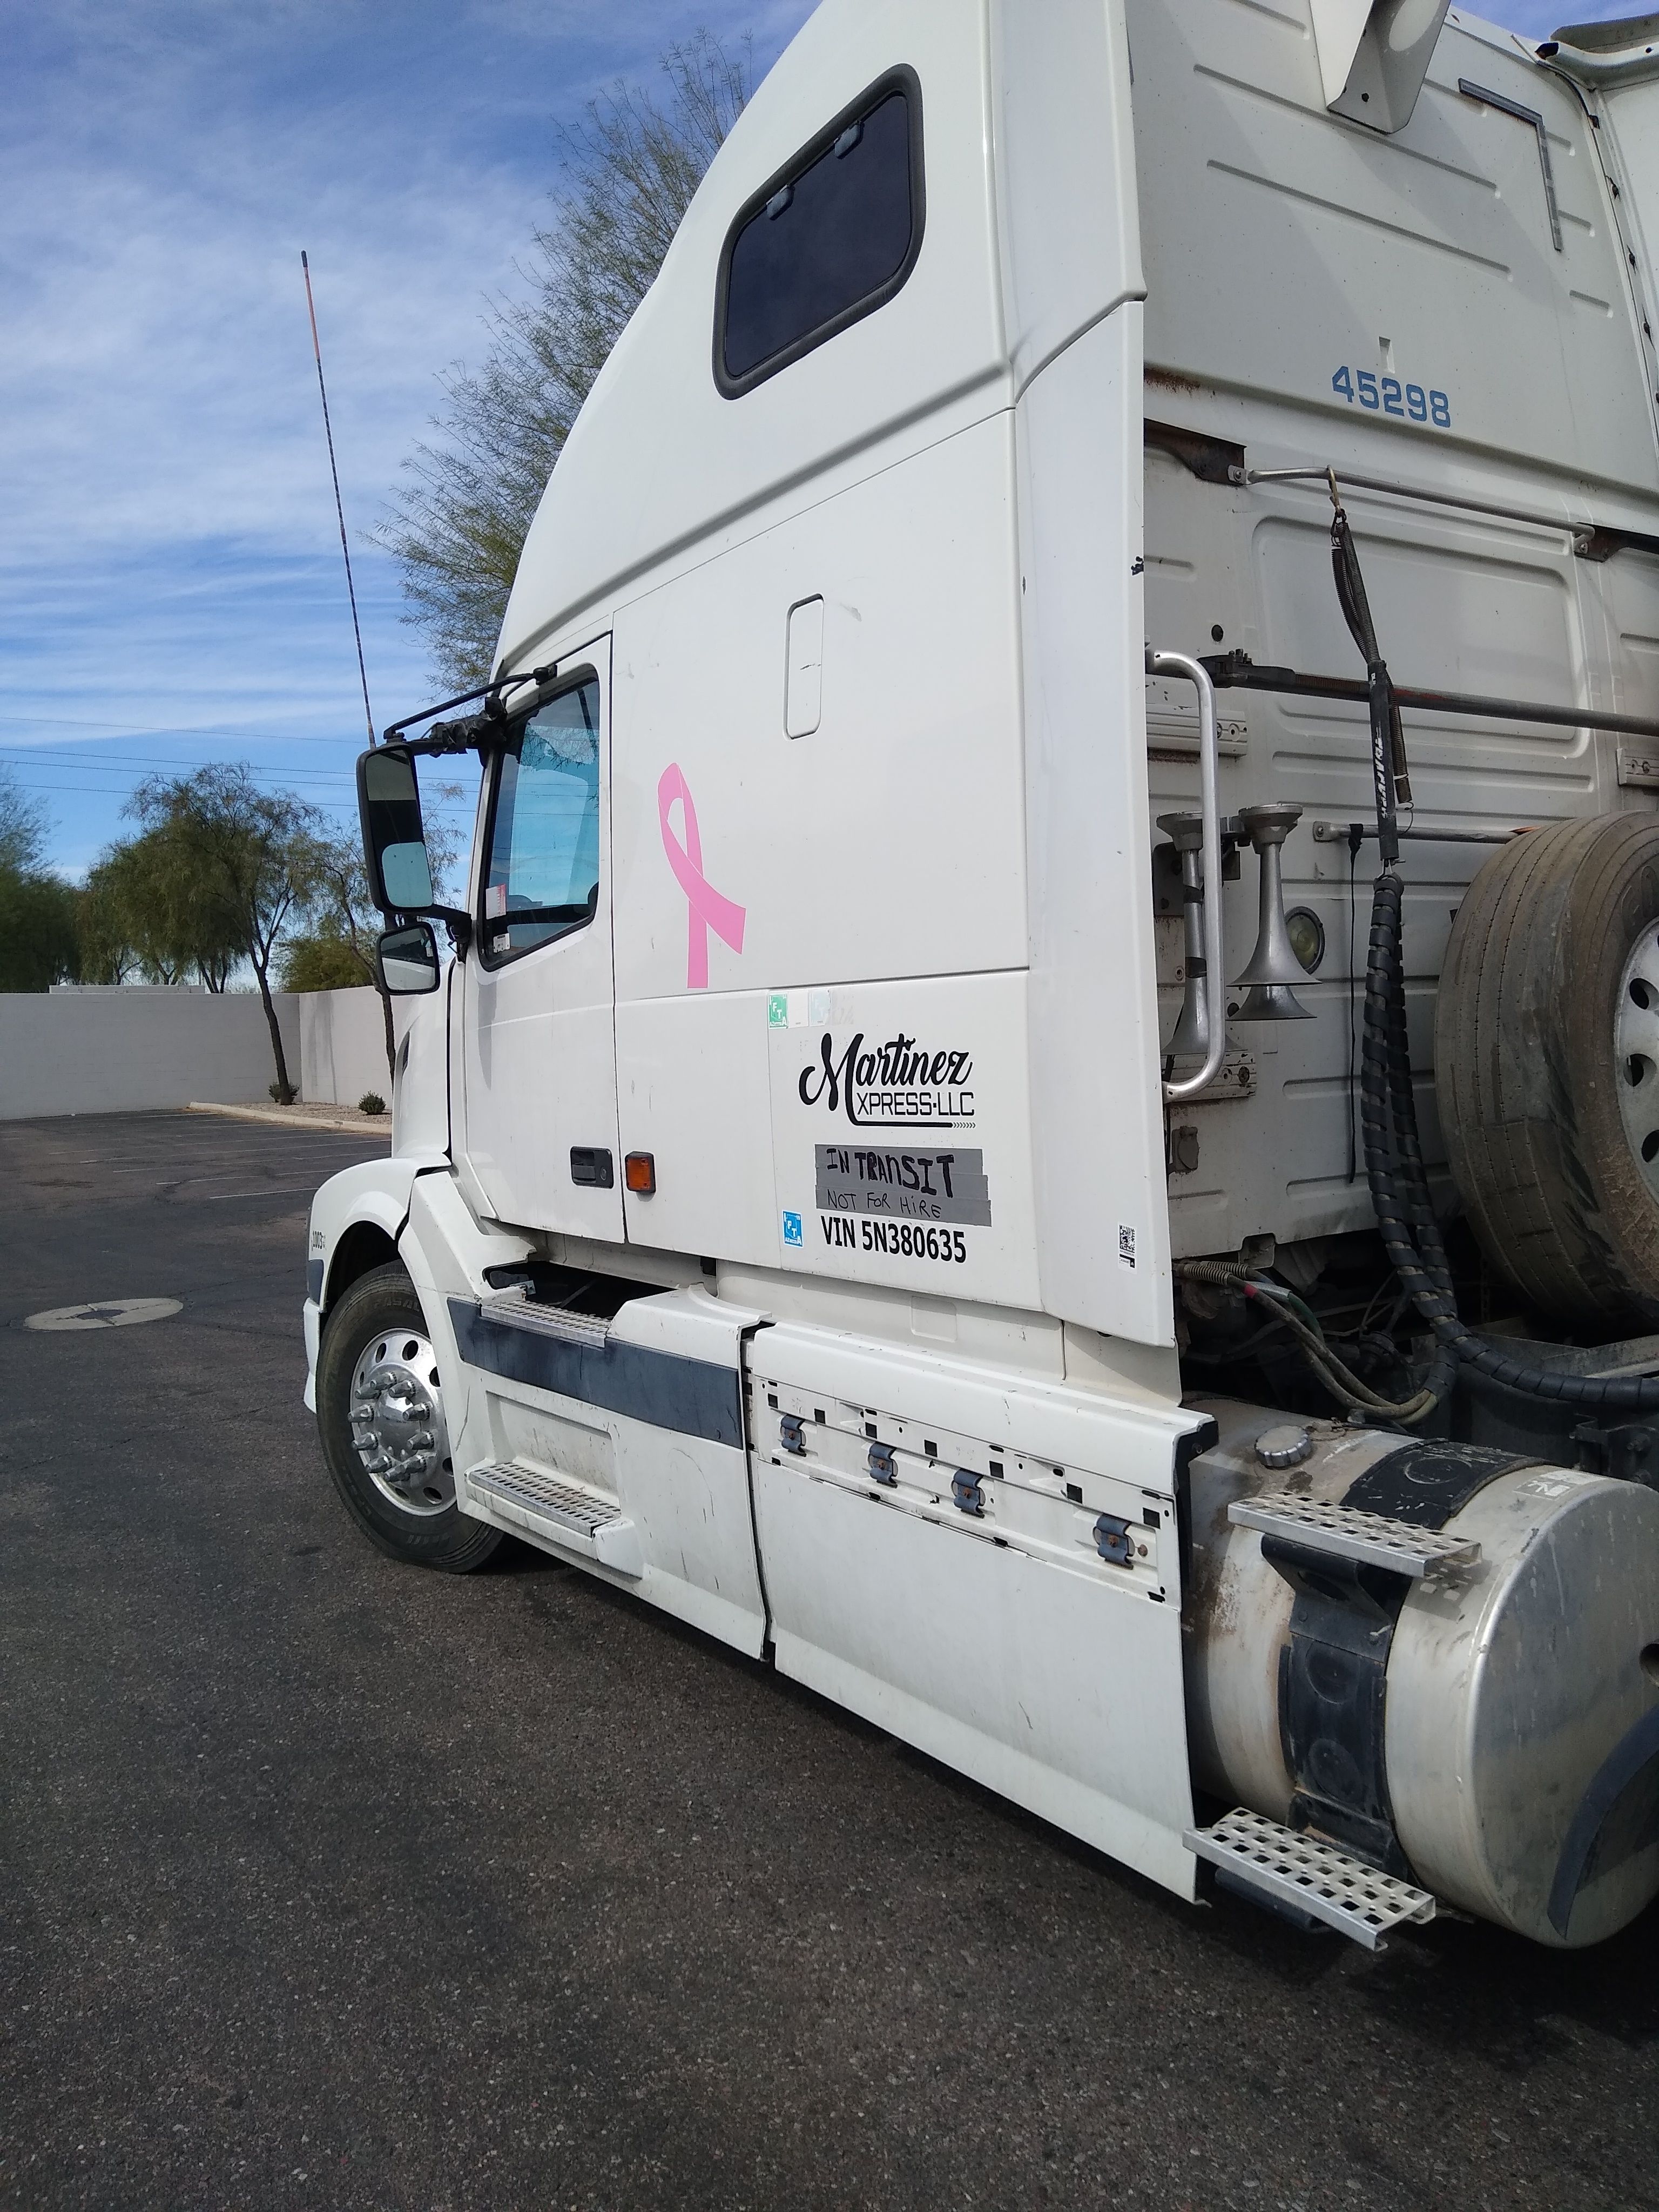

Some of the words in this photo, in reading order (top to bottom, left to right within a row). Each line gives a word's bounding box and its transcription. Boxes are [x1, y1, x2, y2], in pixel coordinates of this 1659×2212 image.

[1332, 366, 1451, 428] 45298
[799, 1033, 973, 1125] Martinez
[826, 1148, 850, 1174] IN
[827, 1189, 857, 1210] NOT
[820, 1216, 856, 1248] VIN
[861, 1220, 966, 1263] 5N380635
